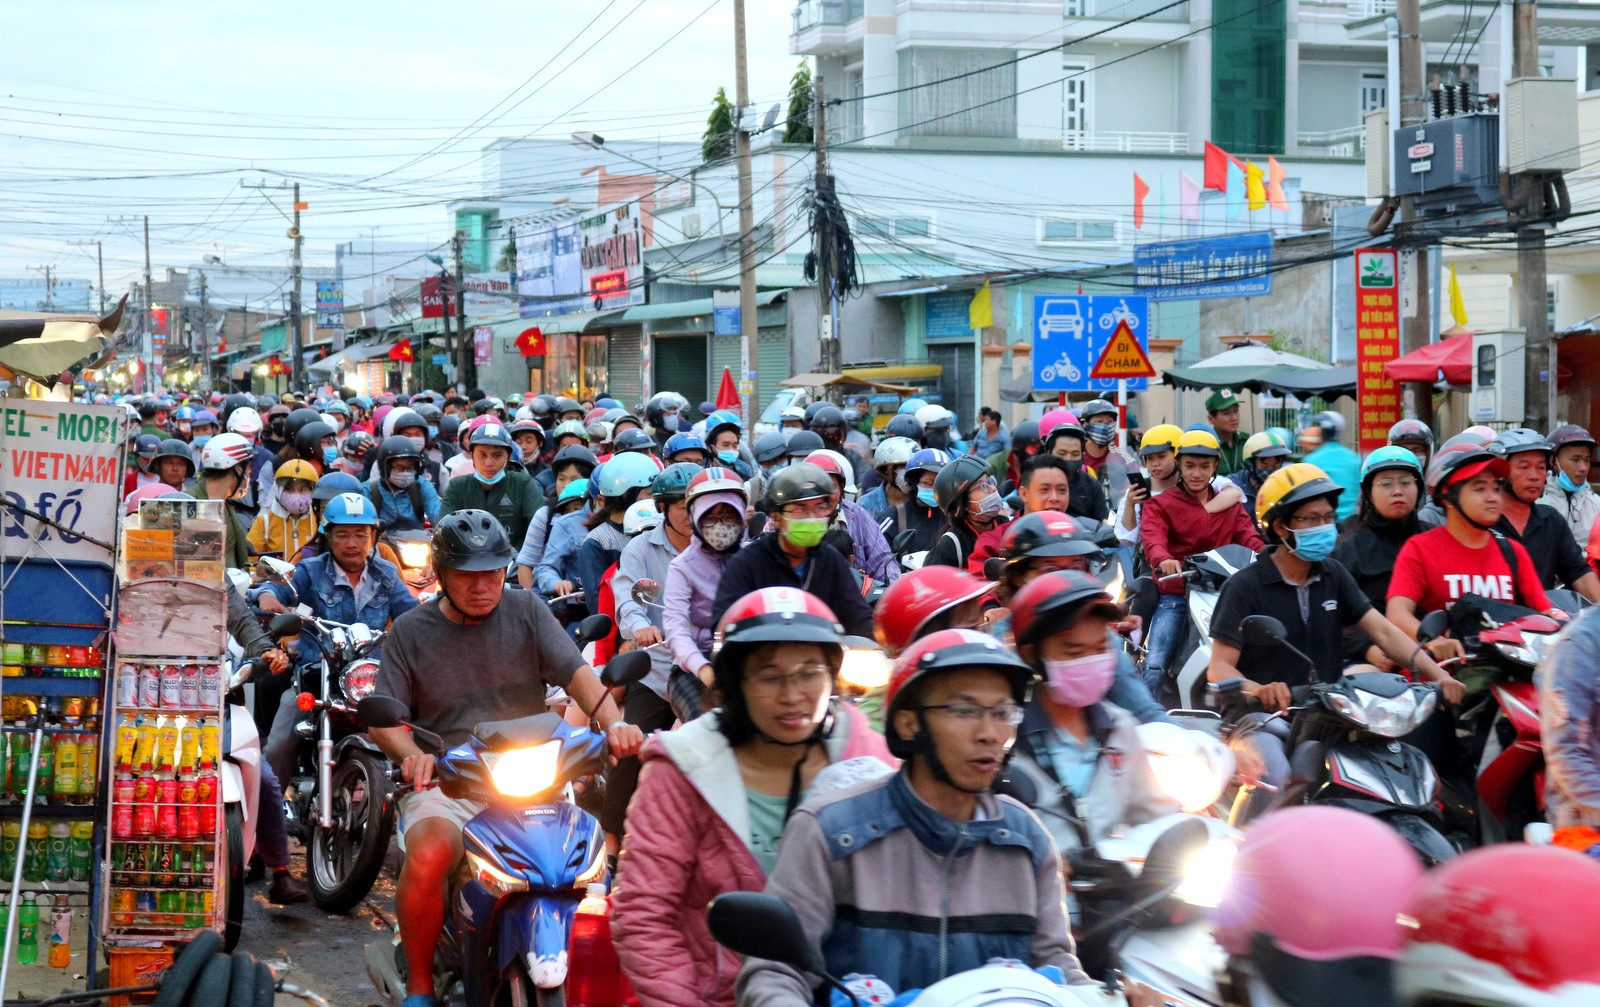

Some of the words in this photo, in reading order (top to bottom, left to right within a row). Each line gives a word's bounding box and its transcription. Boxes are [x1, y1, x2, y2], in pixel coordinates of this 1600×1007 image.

[1117, 342, 1129, 353] ĐI
[0, 407, 31, 438] EL
[11, 449, 117, 485] VIETNAM
[1443, 574, 1514, 600] TIME
